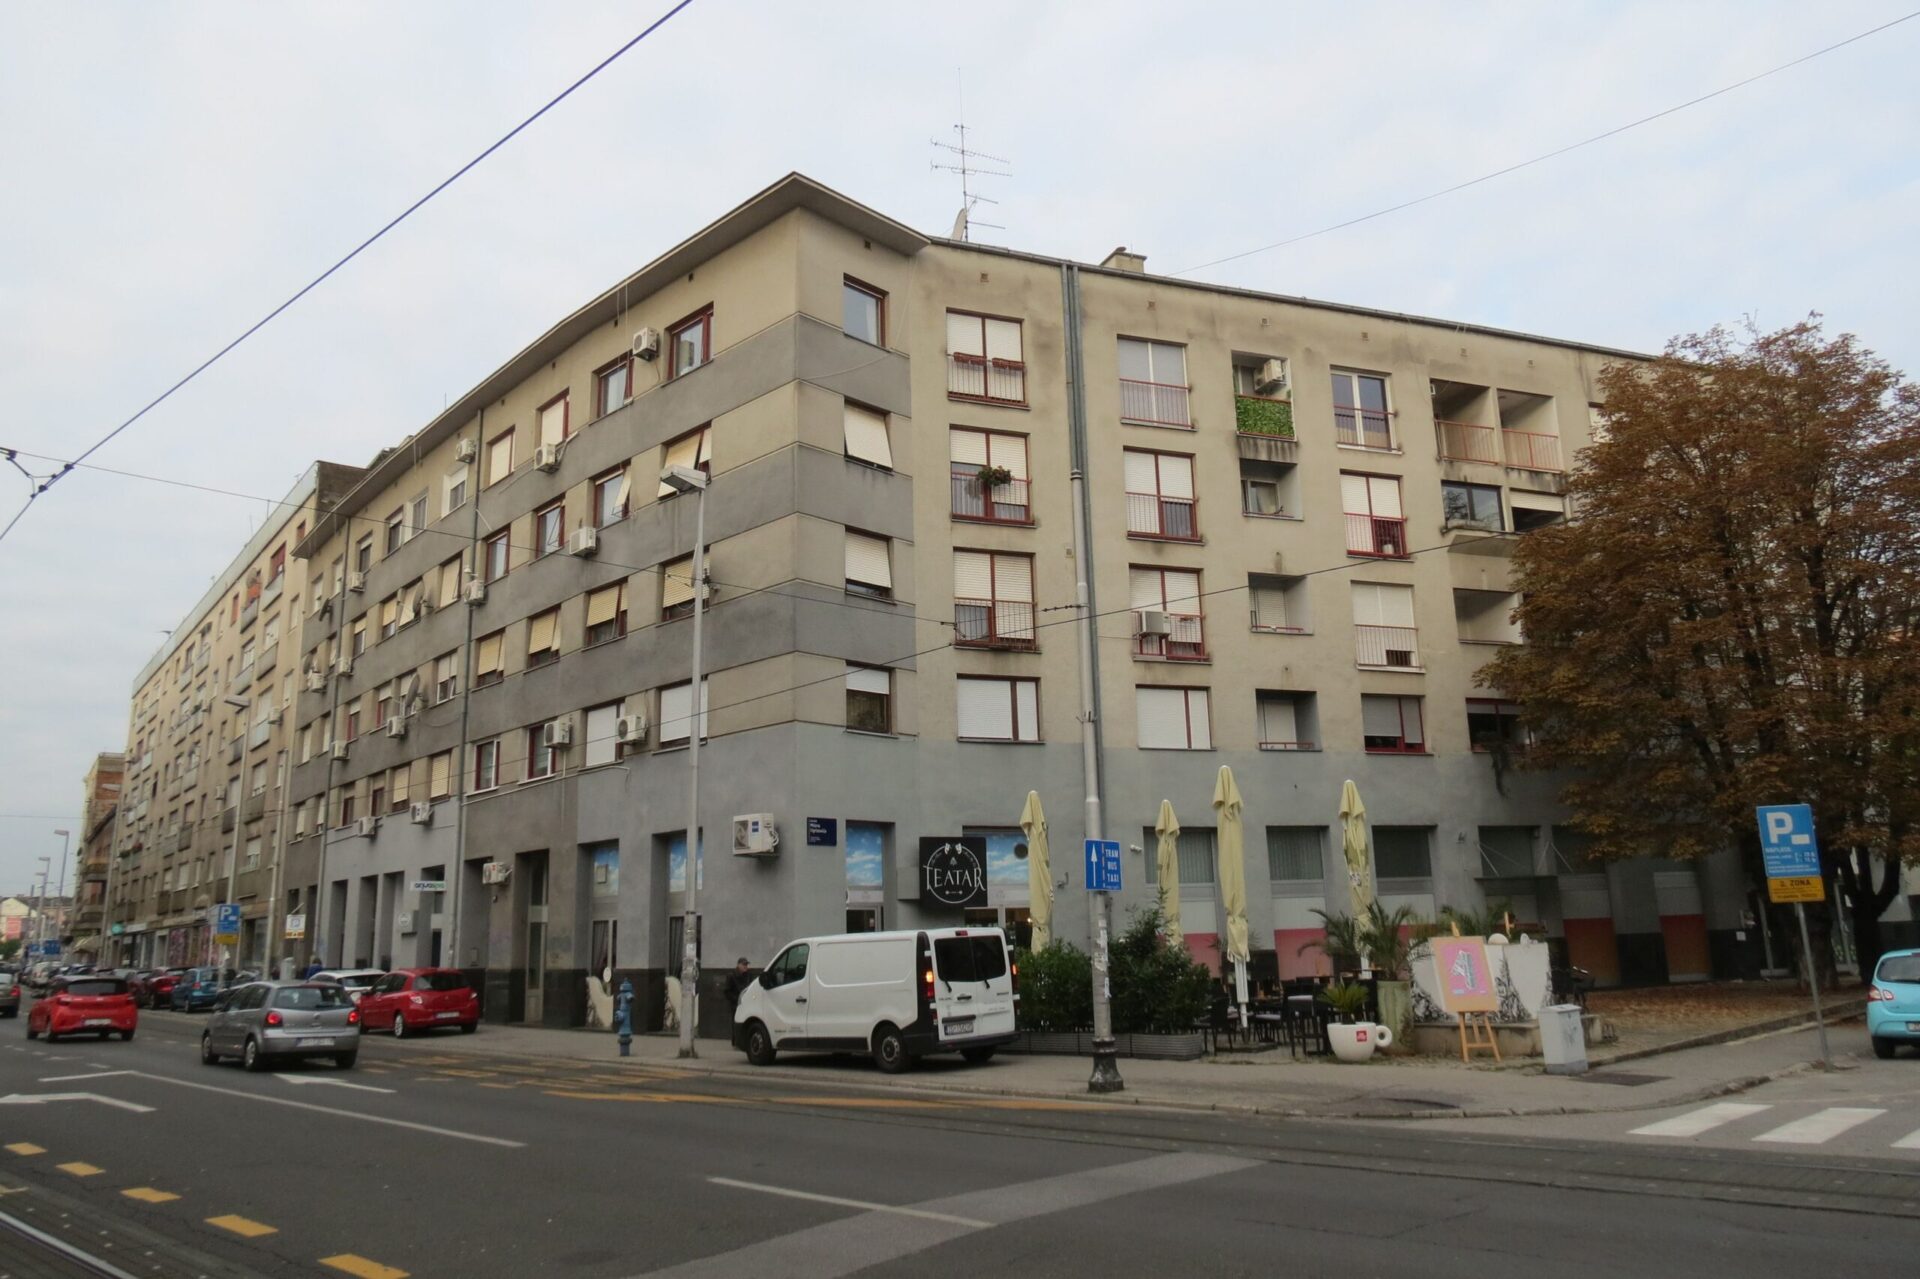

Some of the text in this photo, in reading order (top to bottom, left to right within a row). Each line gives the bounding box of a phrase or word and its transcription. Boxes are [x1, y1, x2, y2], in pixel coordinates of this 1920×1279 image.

[1766, 811, 1793, 844] P
[1105, 849, 1119, 858] TRAM
[1107, 861, 1118, 870] BUS
[922, 864, 986, 891] TEATAR
[1107, 873, 1119, 882] TAXI
[1790, 879, 1811, 887] ZONA
[220, 906, 232, 921] P
